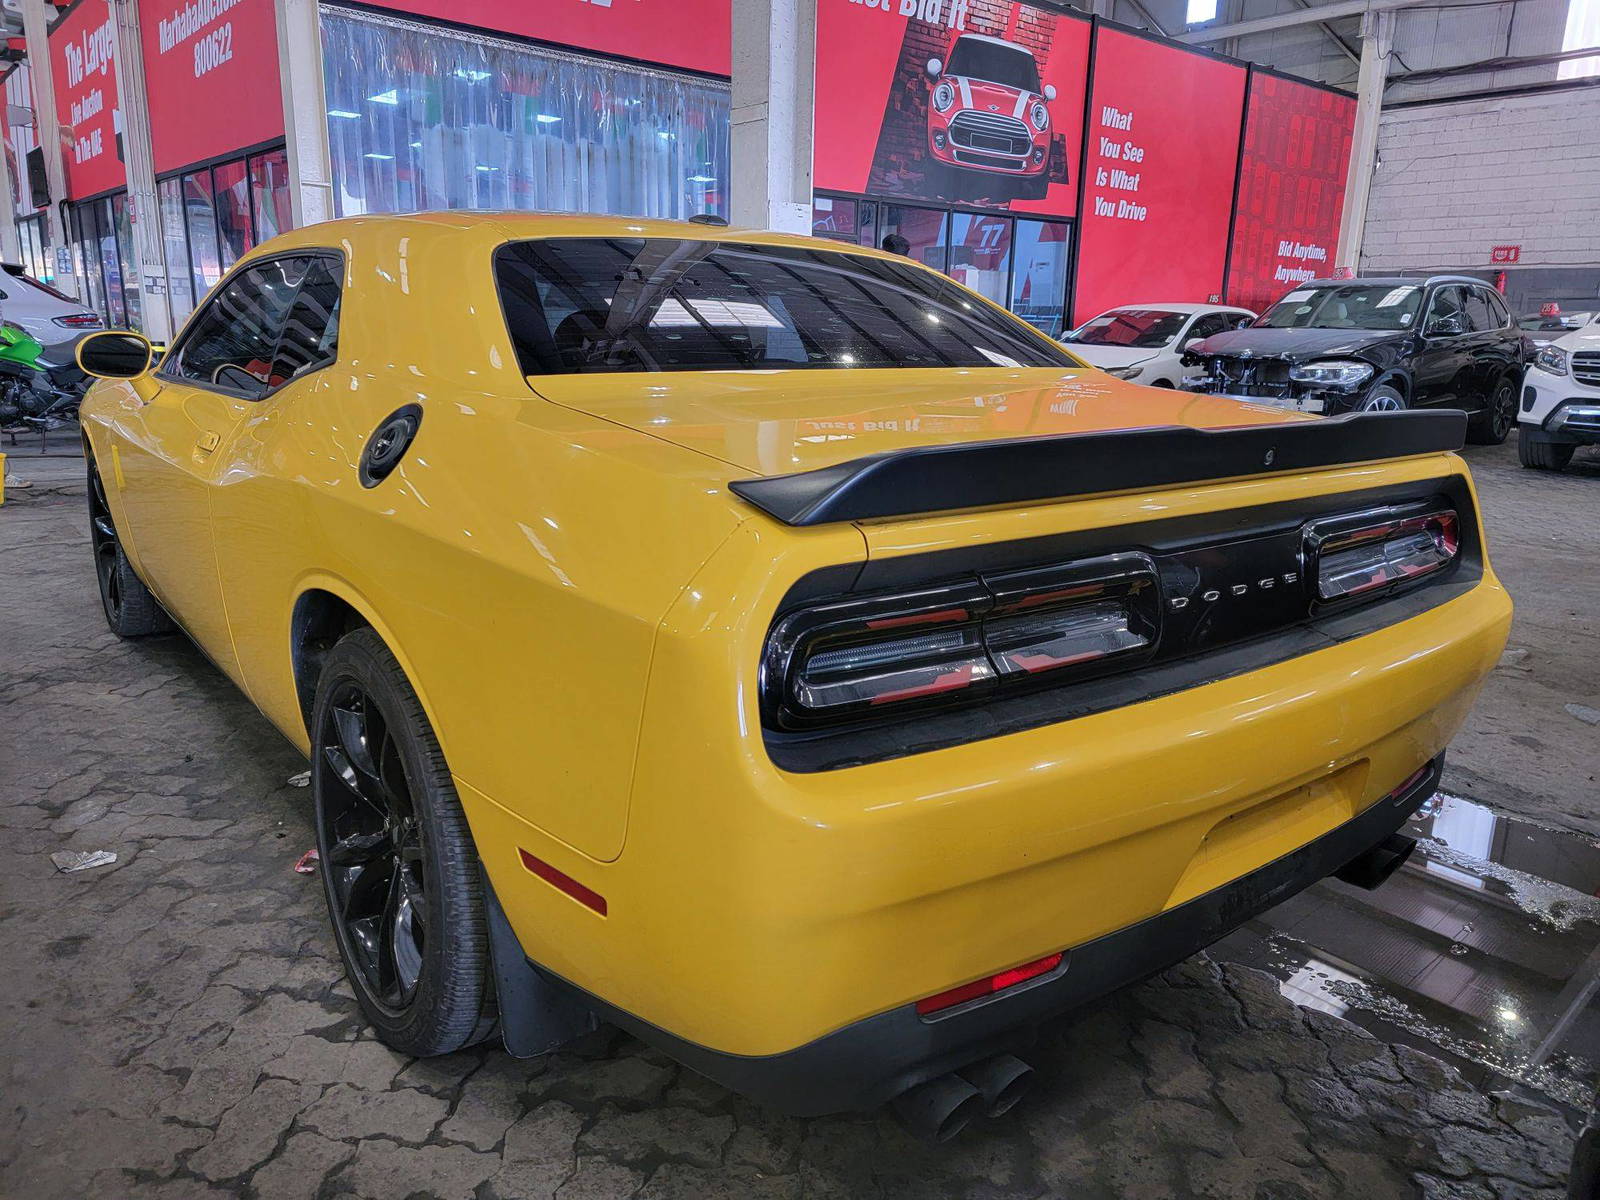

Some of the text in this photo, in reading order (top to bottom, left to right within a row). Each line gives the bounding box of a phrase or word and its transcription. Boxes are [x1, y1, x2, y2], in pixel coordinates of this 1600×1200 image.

[160, 0, 241, 55] MarhabaAuct
[948, 0, 968, 31] It
[65, 42, 83, 88] The
[194, 22, 233, 78] 800622
[82, 88, 103, 121] Auction
[1101, 106, 1133, 131] What
[80, 137, 91, 163] The
[90, 128, 103, 158] UAE
[1099, 136, 1144, 163] You See
[1096, 167, 1140, 191] Is What
[1094, 196, 1147, 222] You Drive
[980, 223, 1005, 248] 77
[1278, 240, 1327, 263] Bid Anytime,
[1170, 571, 1298, 610] DODGE
